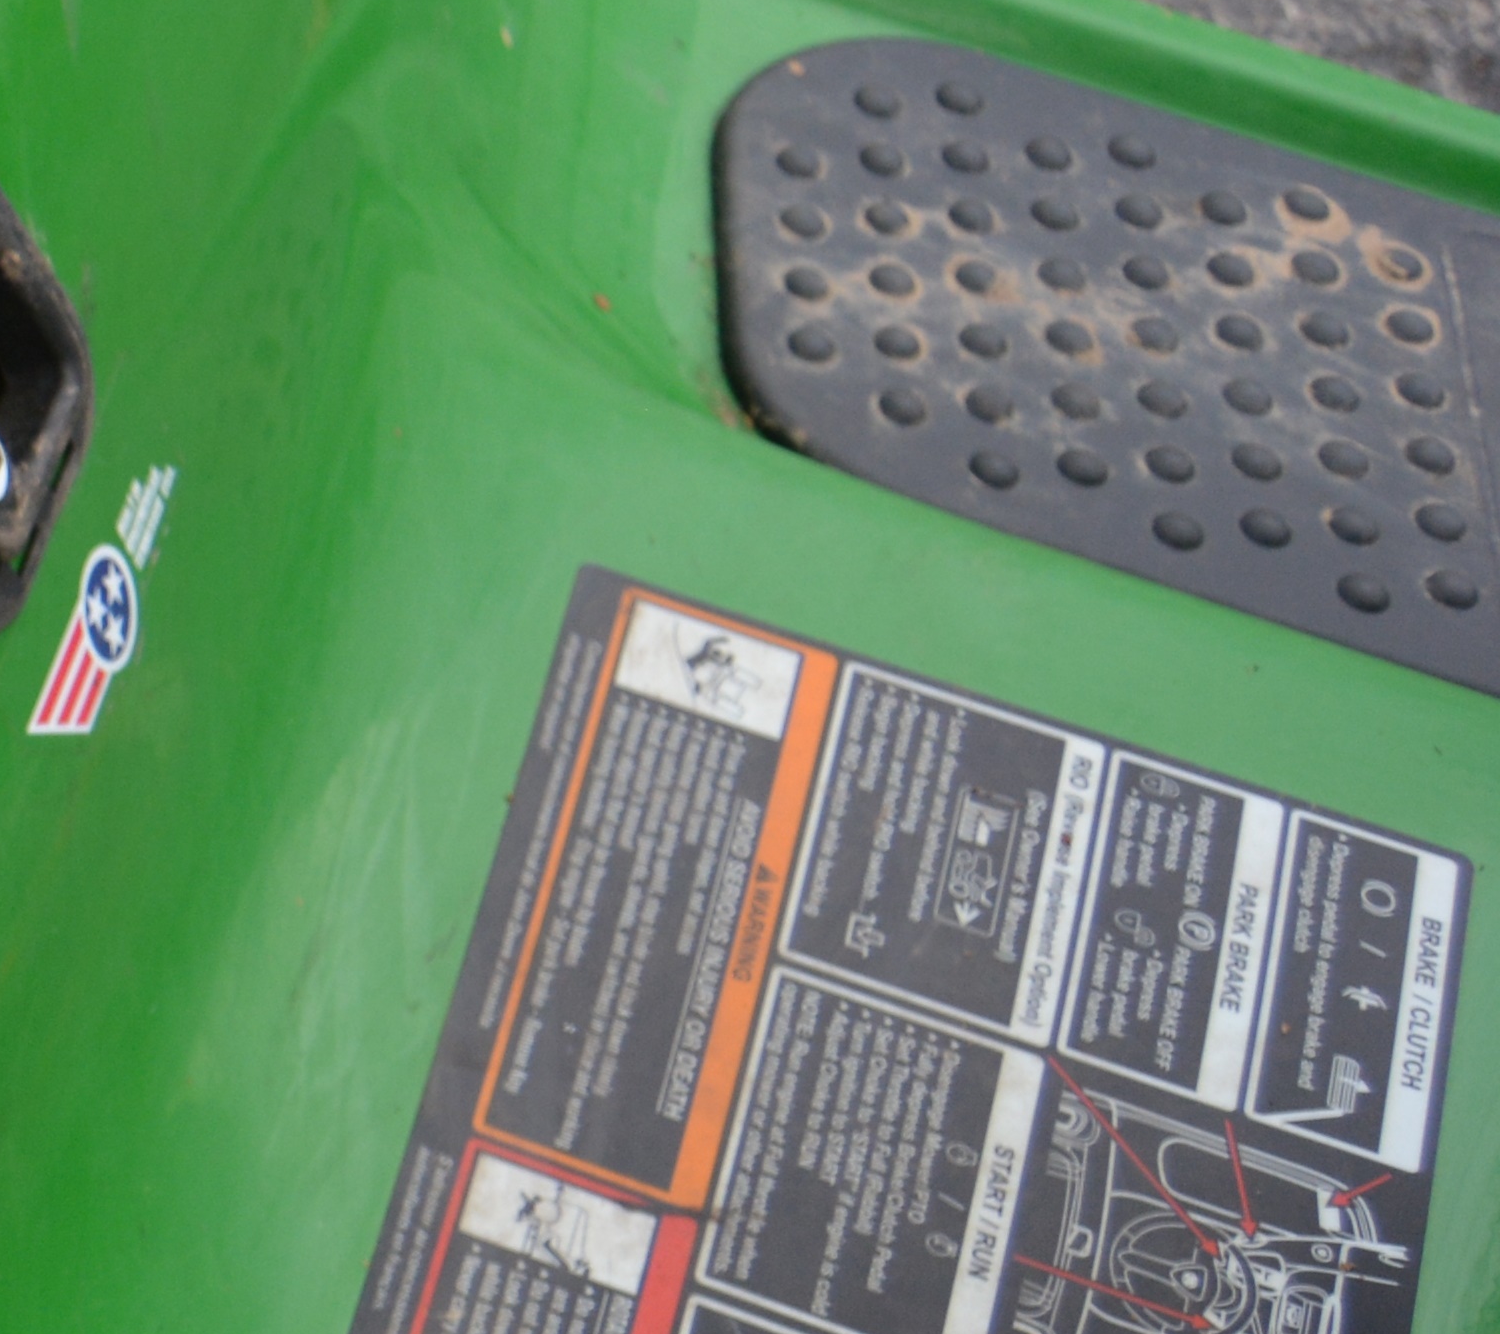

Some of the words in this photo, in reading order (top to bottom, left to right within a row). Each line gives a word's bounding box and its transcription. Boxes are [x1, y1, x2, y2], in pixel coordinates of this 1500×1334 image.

[726, 799, 760, 857] AVOID
[1055, 796, 1083, 866] (Revrse
[709, 859, 745, 942] SERIOUS
[731, 879, 768, 981] WARNING
[1232, 883, 1258, 936] PARK
[692, 944, 724, 1016] INJURY
[1219, 941, 1249, 1012] BRAKE
[1414, 917, 1442, 987] BRAKE
[679, 1019, 705, 1050] OR
[1401, 1007, 1430, 1090] CLUTCH
[664, 1051, 697, 1120] DEATH
[984, 1145, 1015, 1216] START
[968, 1231, 996, 1280] RUN
